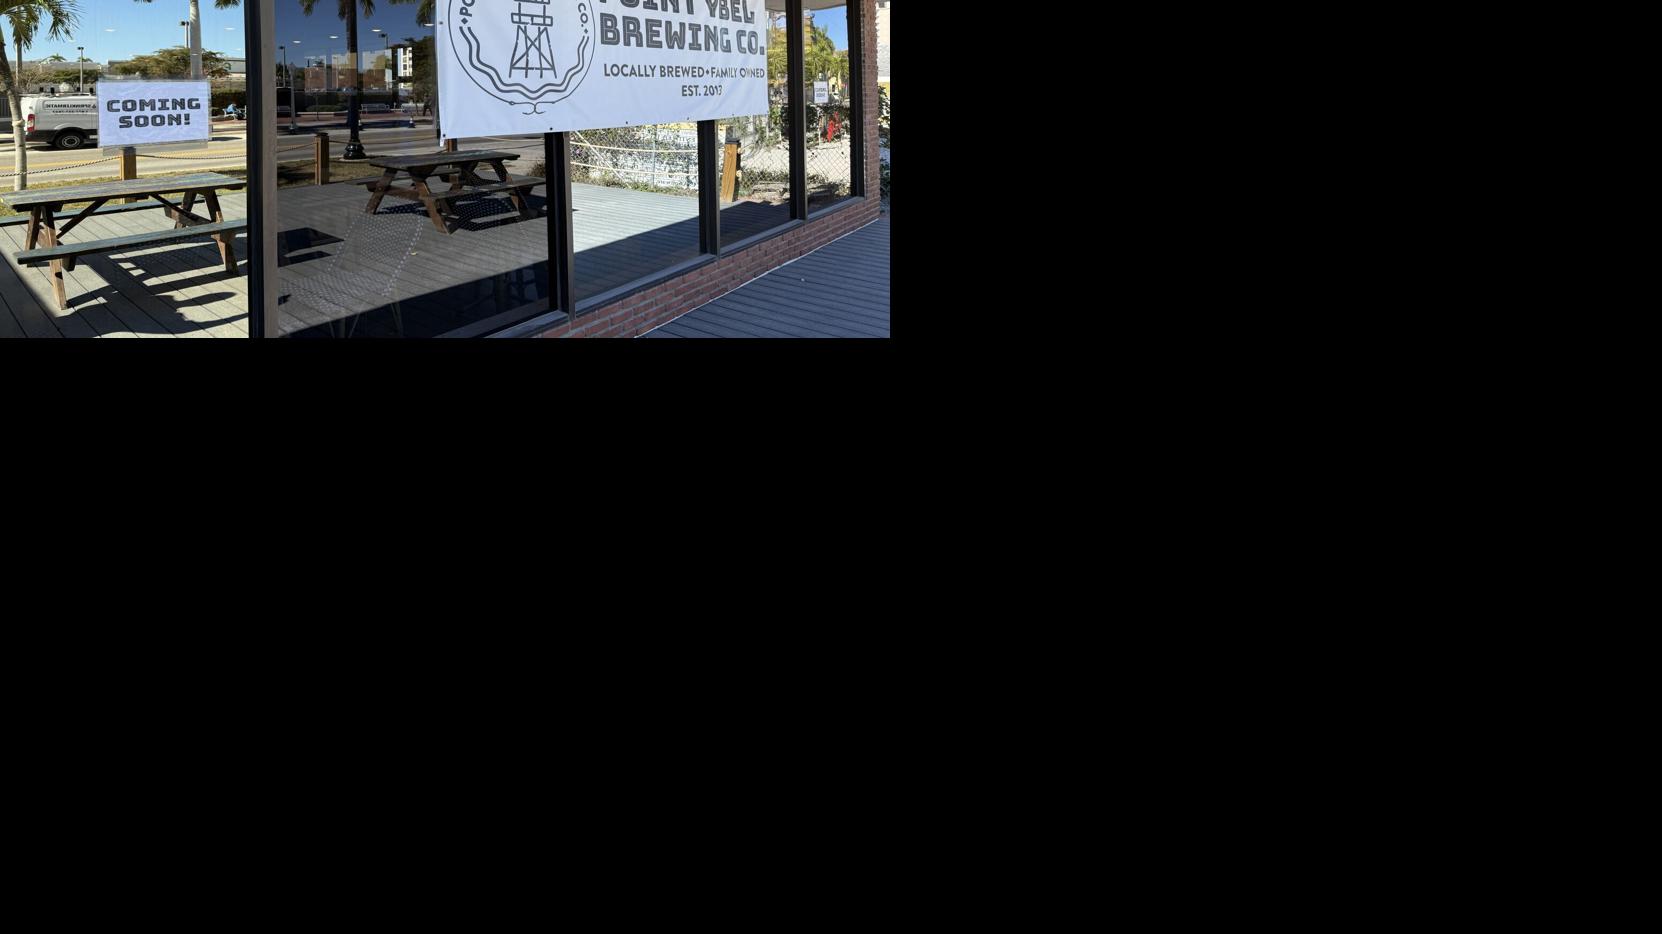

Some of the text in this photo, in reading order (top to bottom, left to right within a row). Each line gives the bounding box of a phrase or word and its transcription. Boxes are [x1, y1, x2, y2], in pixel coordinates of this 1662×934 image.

[577, 2, 589, 28] CO.
[600, 12, 766, 56] BREWING CO.
[603, 63, 657, 78] LOCALLY
[659, 65, 705, 78] BREWED
[710, 66, 738, 79] FAMILY
[681, 84, 723, 97] EST. 2013
[106, 97, 201, 113] COMING
[119, 113, 191, 128] SOON!
